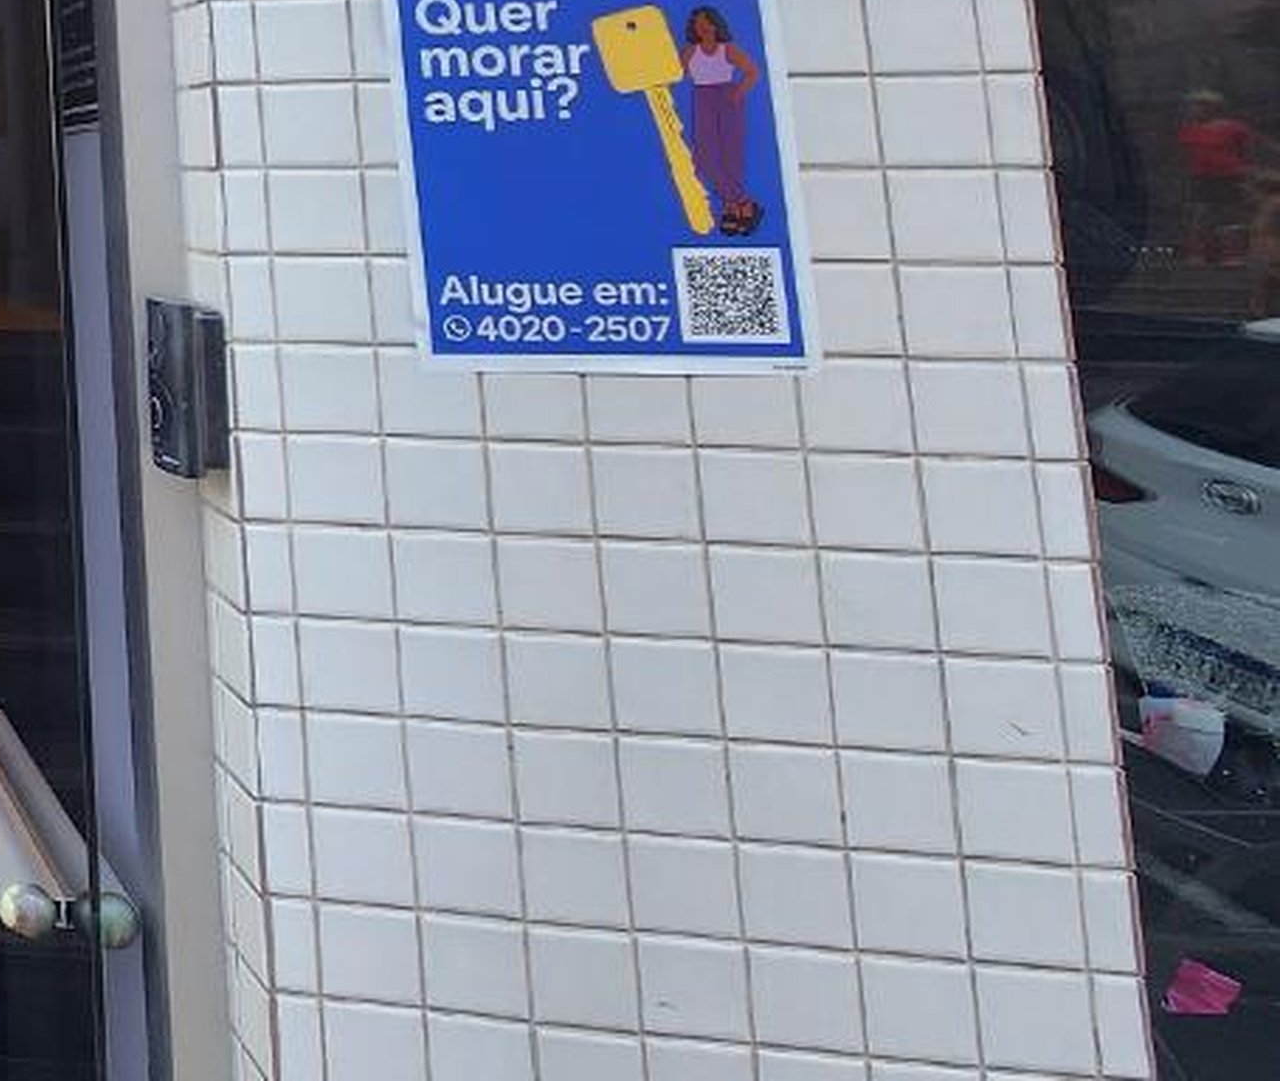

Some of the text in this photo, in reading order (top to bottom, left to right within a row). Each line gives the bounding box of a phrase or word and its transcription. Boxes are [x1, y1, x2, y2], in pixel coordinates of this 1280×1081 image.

[420, 41, 589, 78] morar
[424, 77, 579, 130] aqui?
[441, 276, 669, 313] Alugue em:
[477, 315, 671, 343] 4020-2507
